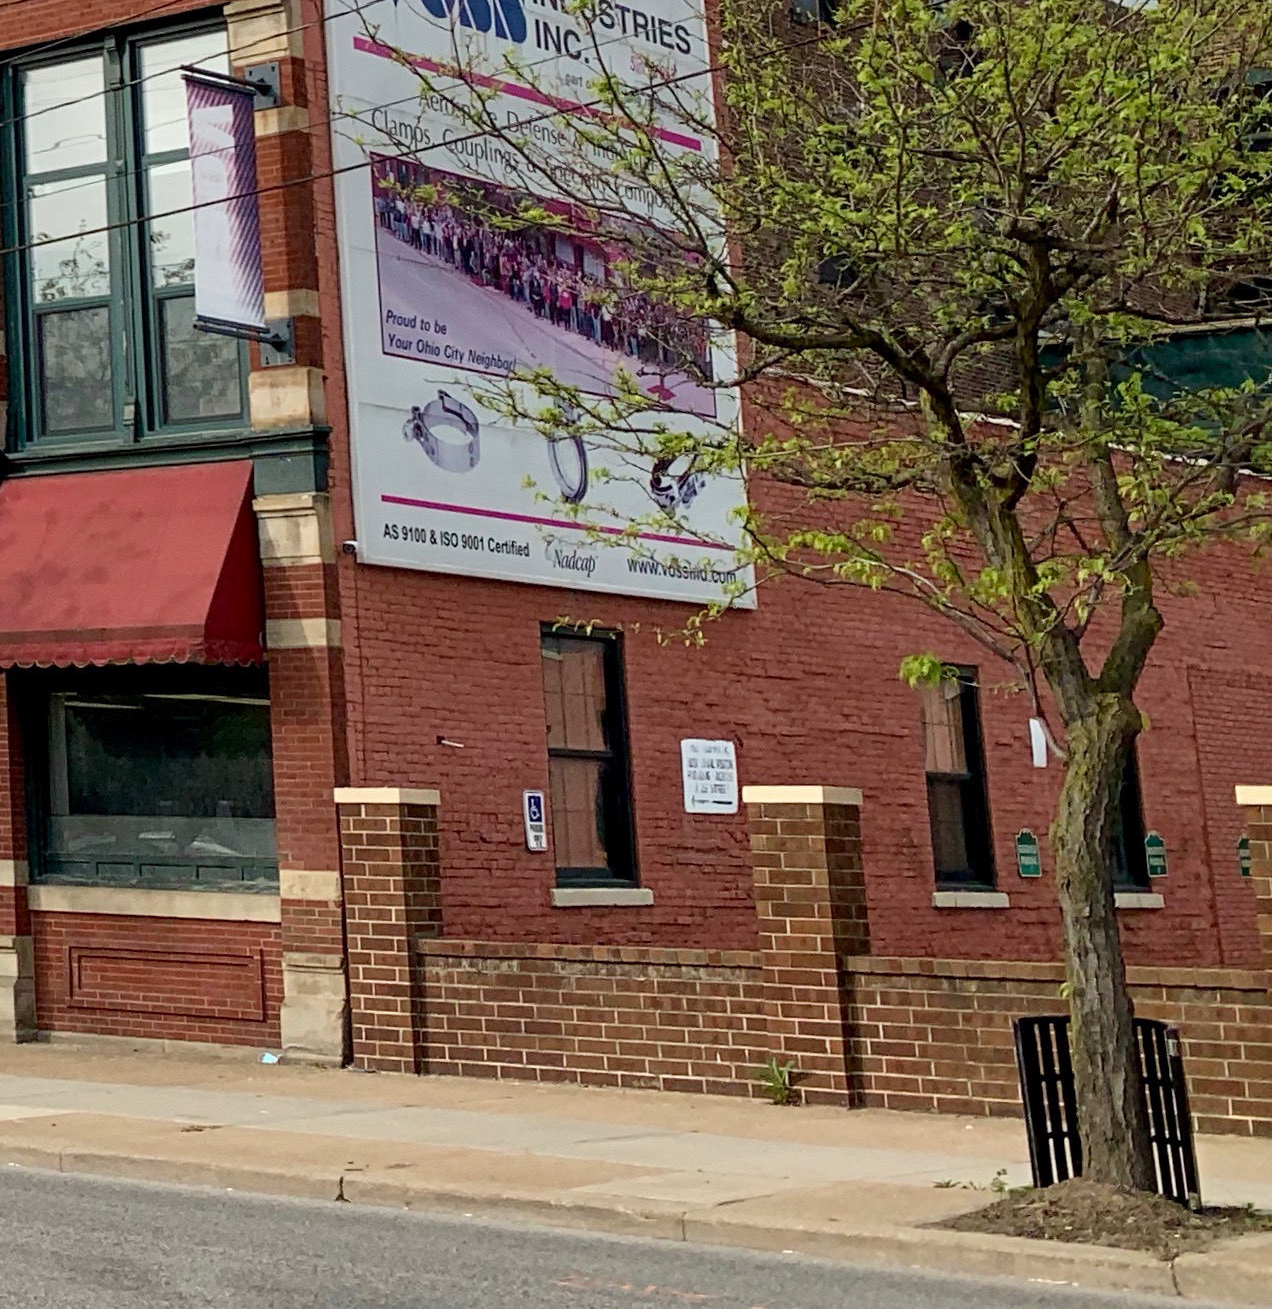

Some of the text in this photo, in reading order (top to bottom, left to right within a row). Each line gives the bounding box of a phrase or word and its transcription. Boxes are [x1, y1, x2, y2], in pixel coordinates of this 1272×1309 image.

[535, 19, 590, 64] INC.
[419, 92, 498, 127] Aeropce
[507, 110, 566, 146] Defense
[372, 109, 435, 149] Clamps,
[443, 128, 519, 175] Couplings
[386, 309, 447, 335] Proud to be
[388, 333, 413, 351] Your
[416, 339, 441, 357] Ohio
[444, 345, 465, 364] City
[383, 523, 530, 557] AS 9100 & ISO 9001 Certified
[553, 549, 596, 577] Nadcap
